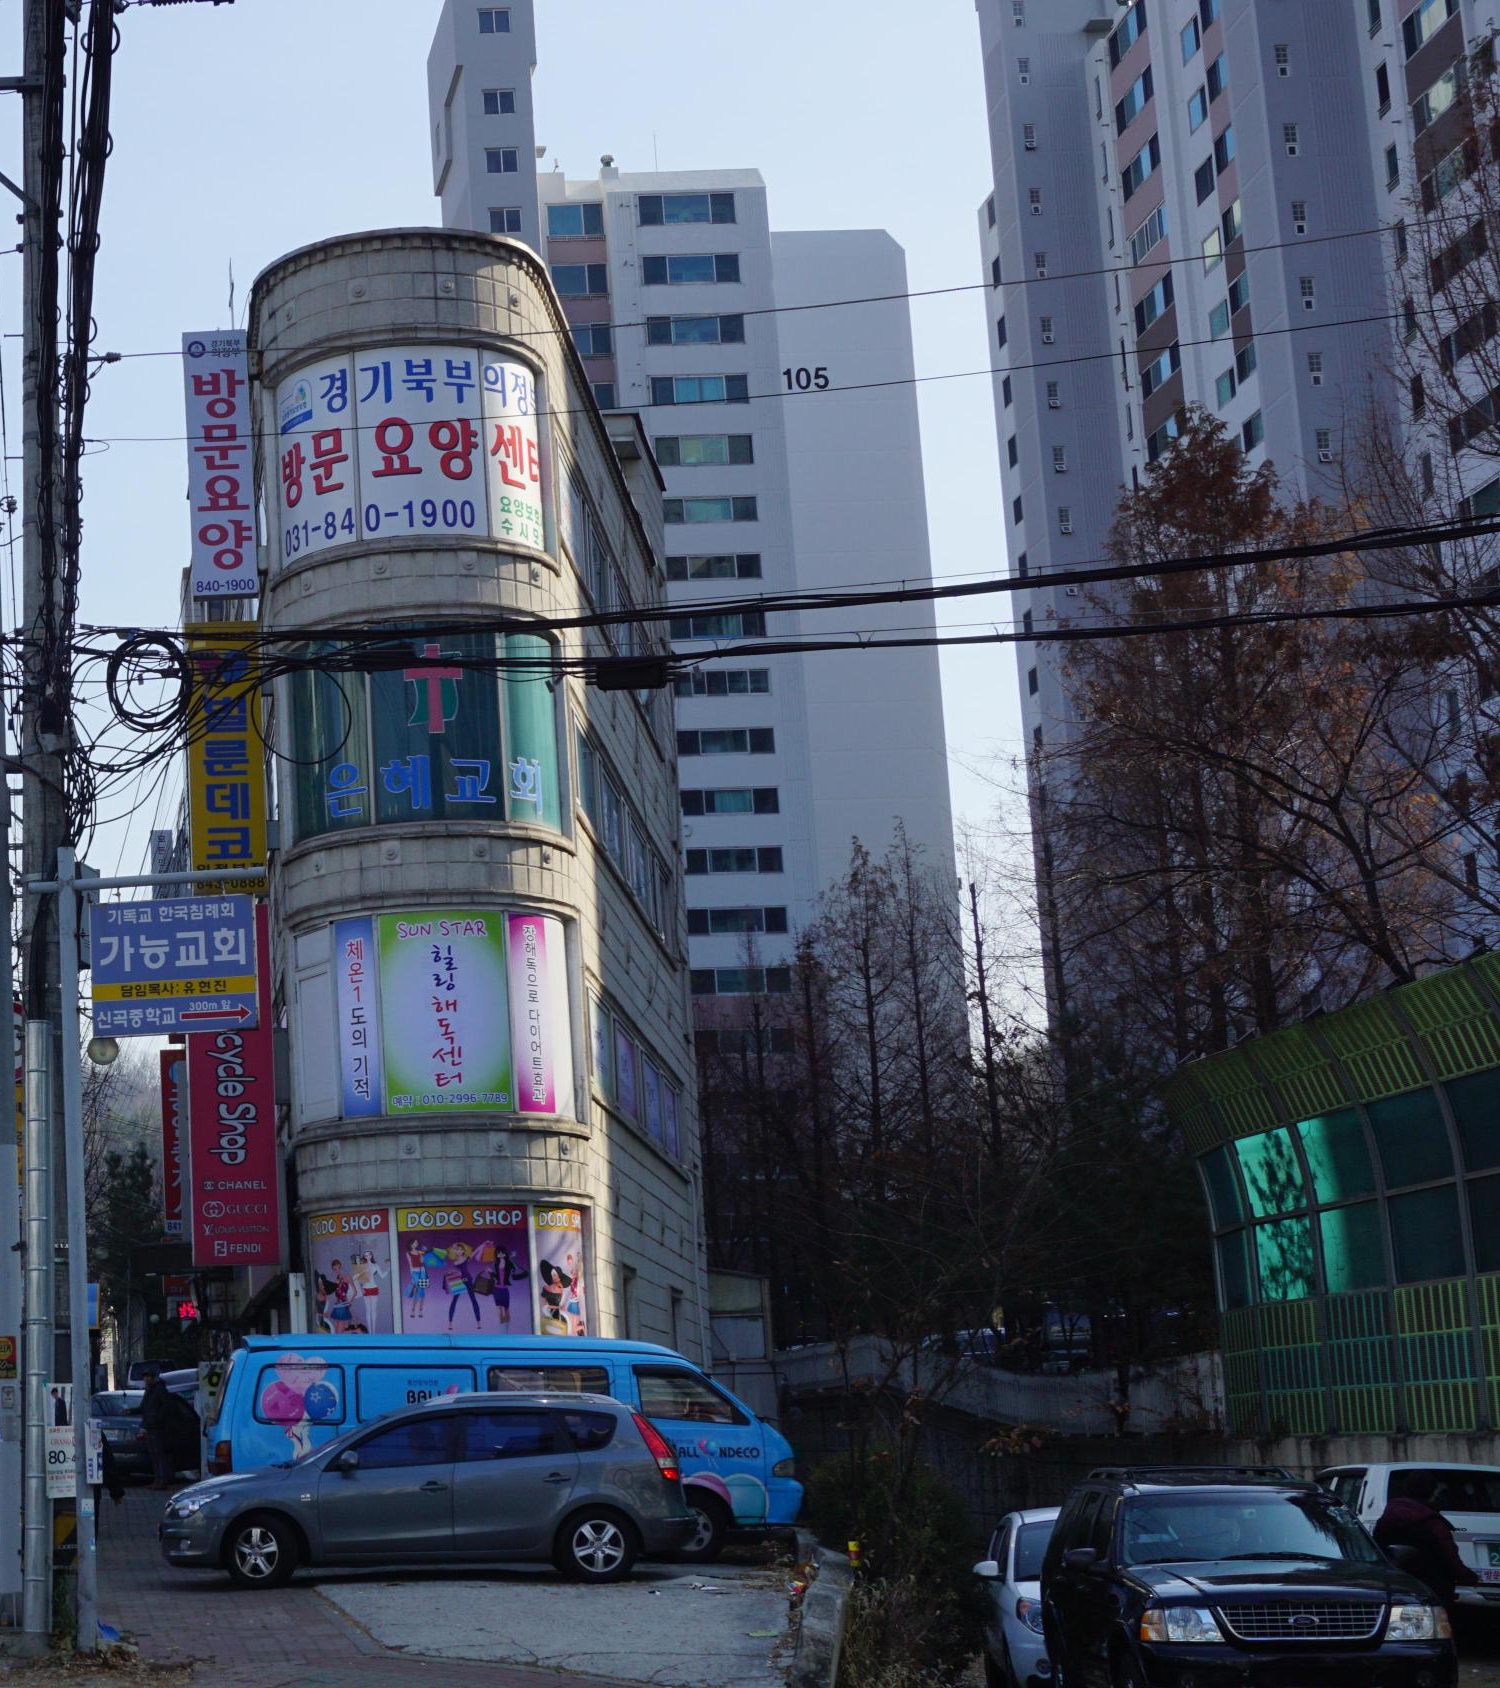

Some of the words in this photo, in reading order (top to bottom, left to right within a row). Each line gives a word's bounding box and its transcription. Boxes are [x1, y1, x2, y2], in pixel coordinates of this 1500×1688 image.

[782, 366, 830, 390] 105
[191, 368, 254, 571] 방문요양
[196, 578, 255, 593] 840-1900
[324, 754, 543, 818] 은혜교회
[107, 908, 153, 925] 기독교
[158, 902, 235, 922] 한국침례회
[397, 921, 432, 940] SUN
[438, 919, 487, 938] STAR
[99, 927, 247, 972] 가능교회
[189, 1001, 218, 1011] 300m
[97, 1008, 176, 1028] 신곡중학교
[206, 1030, 258, 1098] cycle
[392, 1095, 413, 1108] 예약
[210, 1102, 258, 1165] Shop
[217, 1180, 268, 1191] CHANEL
[227, 1204, 268, 1215] GUCCI
[406, 1210, 464, 1229] DODO
[472, 1209, 523, 1226] SHOP
[341, 1213, 382, 1232] SHOP
[230, 1243, 262, 1253] FENDI
